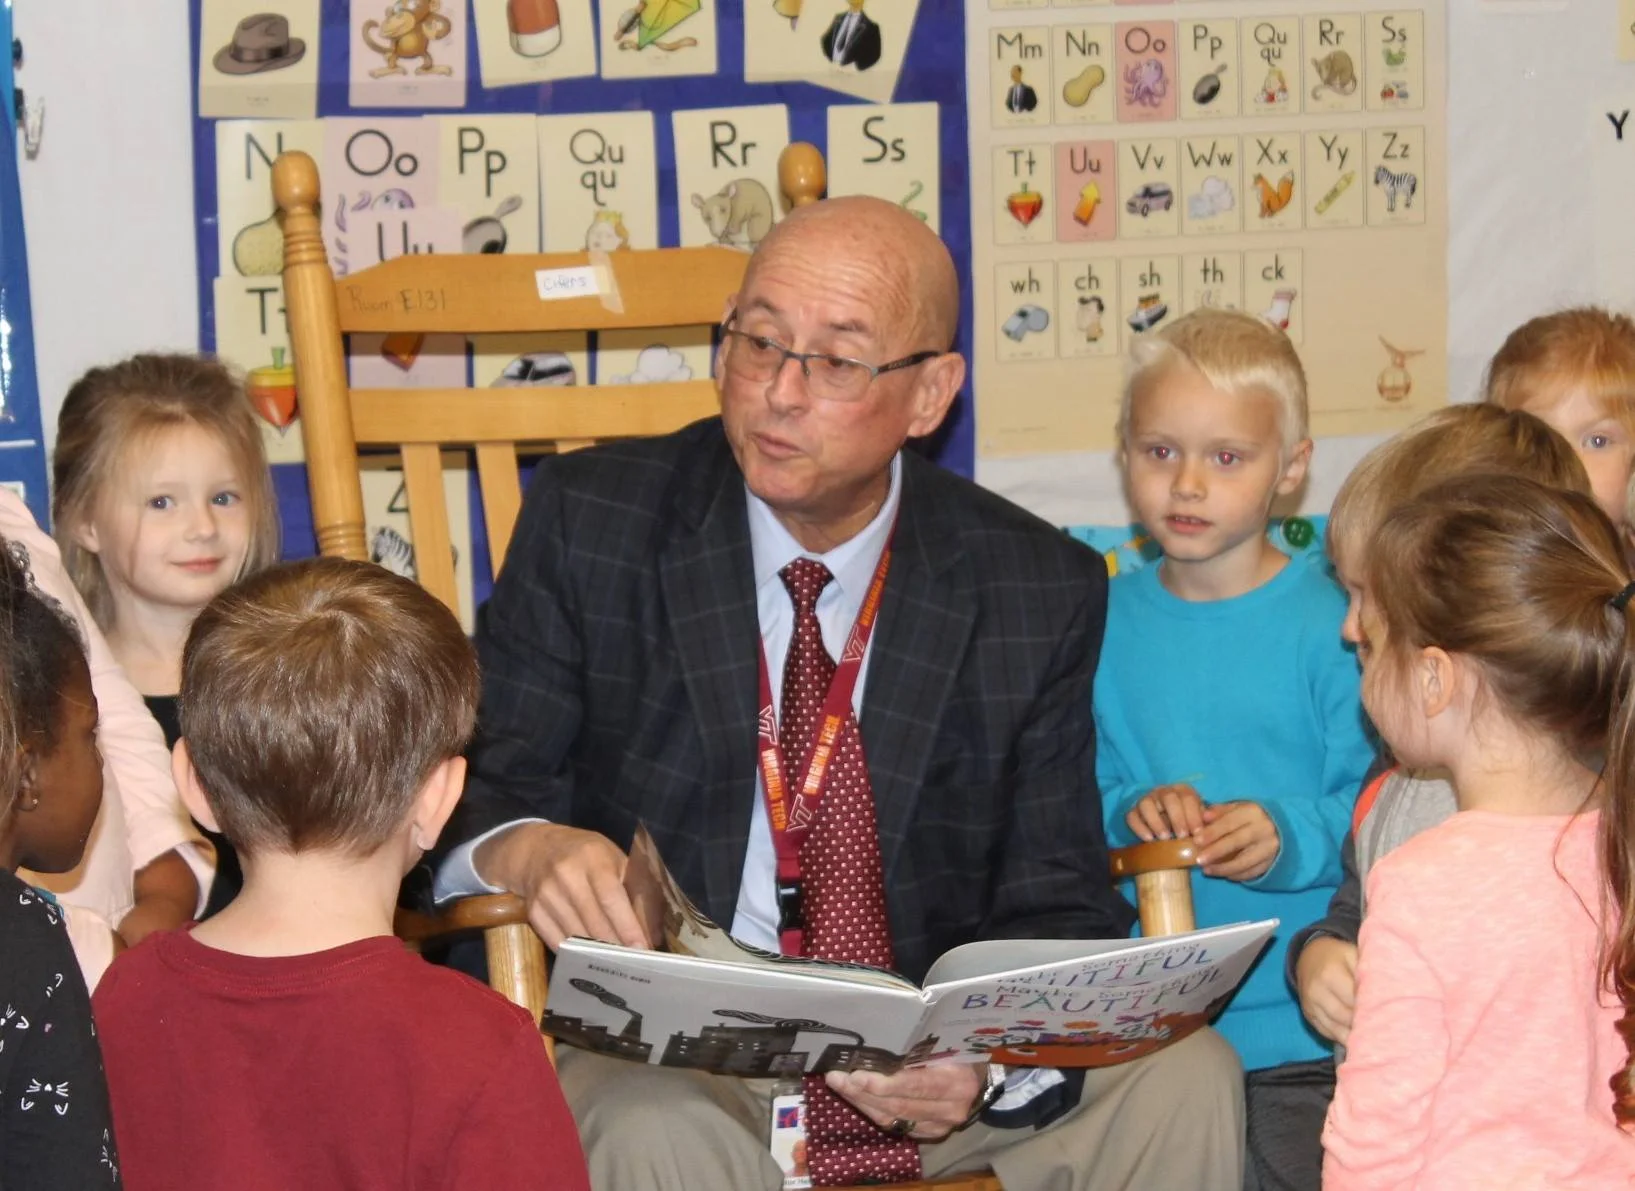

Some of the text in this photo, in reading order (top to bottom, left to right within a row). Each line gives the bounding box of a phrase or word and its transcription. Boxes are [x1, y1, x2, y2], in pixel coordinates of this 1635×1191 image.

[1066, 29, 1099, 57] Nn
[1125, 27, 1167, 54] Oo
[1193, 24, 1222, 60] Pp
[1254, 22, 1287, 45] Qu
[1319, 19, 1345, 46] Rr
[1381, 16, 1407, 43] Ss
[997, 32, 1042, 60] Mm
[1260, 47, 1282, 67] qu
[862, 115, 906, 163] Ss
[1606, 110, 1629, 140] Y
[345, 129, 418, 177] Oo
[569, 128, 624, 164] Qu
[709, 120, 757, 168] Rr
[1131, 143, 1164, 170] Vv
[1187, 141, 1233, 168] Ww
[1256, 137, 1288, 165] Xx
[1319, 134, 1348, 170] Yy
[1382, 132, 1410, 160] Zz
[458, 126, 507, 198] Pp
[1007, 149, 1036, 177] Tt
[1069, 147, 1101, 174] Uu
[580, 169, 617, 206] qu
[1010, 266, 1040, 294] wh
[1074, 264, 1099, 291] ch
[1138, 260, 1161, 288] sh
[1200, 257, 1224, 284] th
[1262, 254, 1285, 281] ck
[819, 714, 841, 746] TECH
[961, 968, 1222, 1014] BEAUTIFUL
